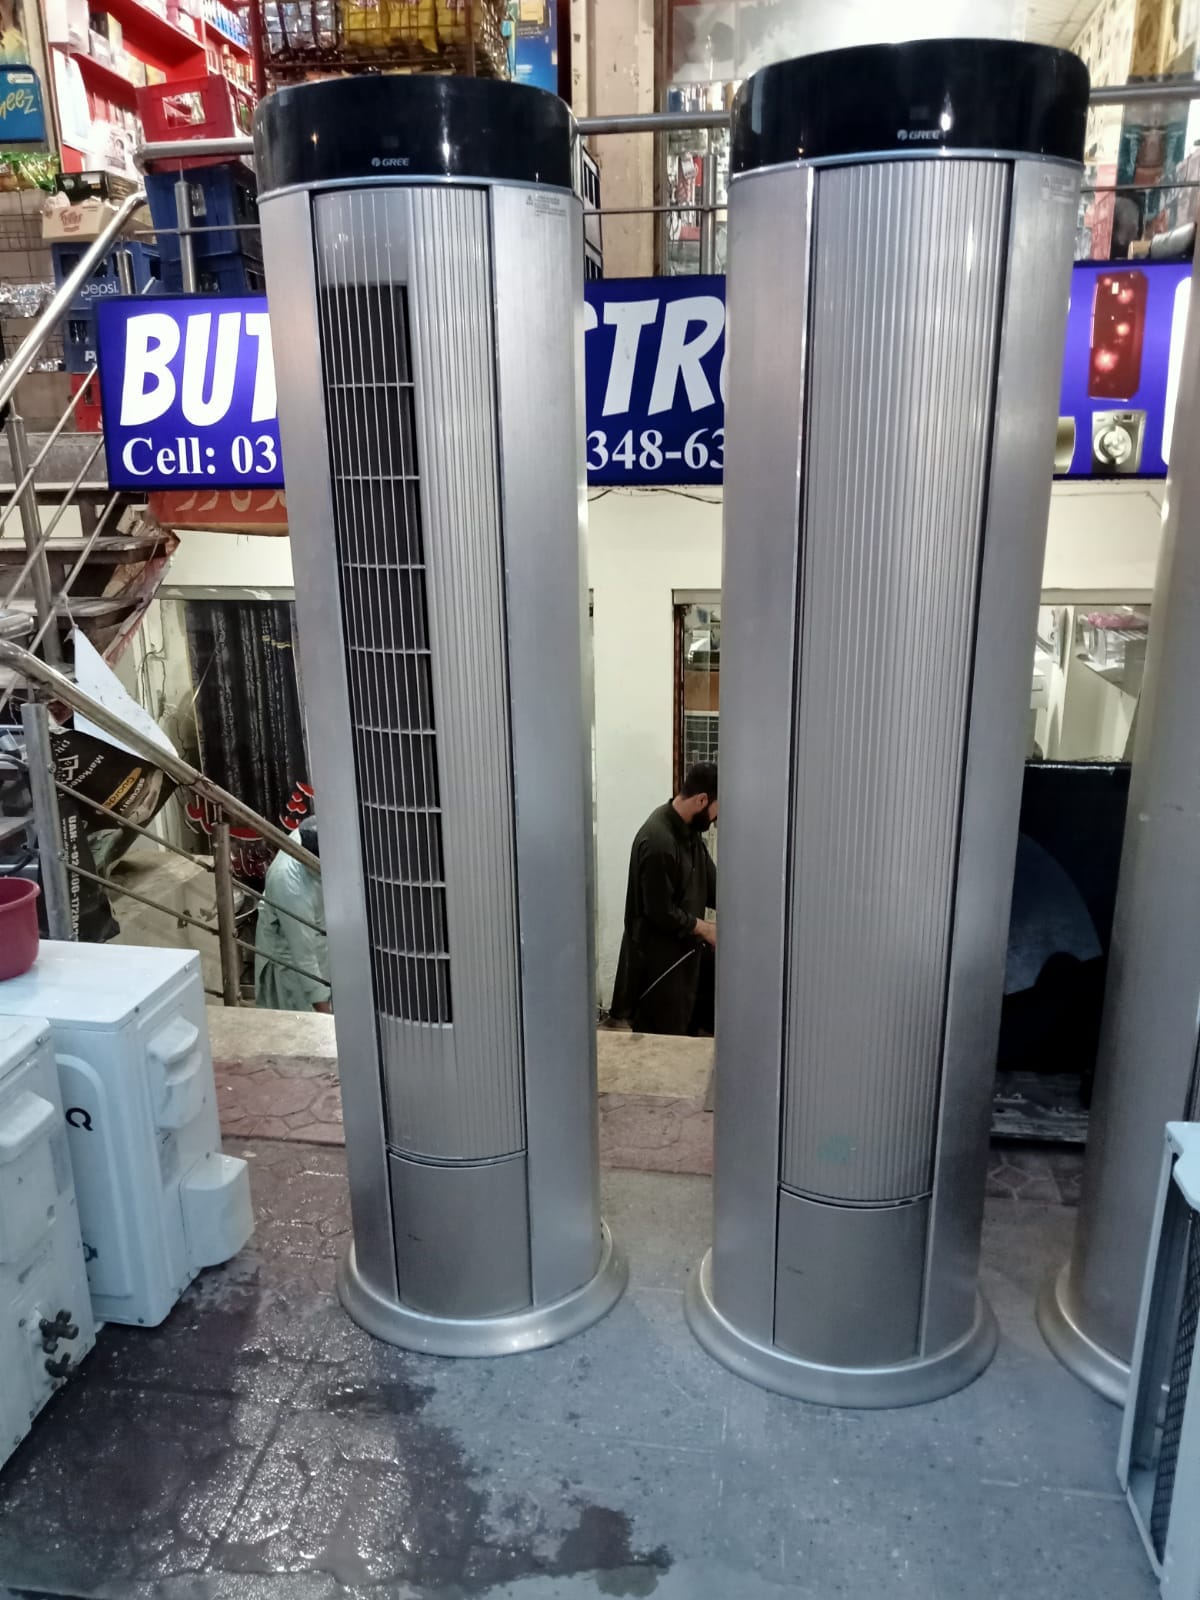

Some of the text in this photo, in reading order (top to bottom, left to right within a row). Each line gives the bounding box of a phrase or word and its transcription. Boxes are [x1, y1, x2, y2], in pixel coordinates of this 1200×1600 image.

[909, 130, 940, 140] GREE
[382, 158, 409, 167] GREE
[120, 312, 278, 426] BUT
[584, 296, 726, 416] TR
[122, 435, 277, 476] Cell: 03
[587, 428, 724, 470] 348-63
